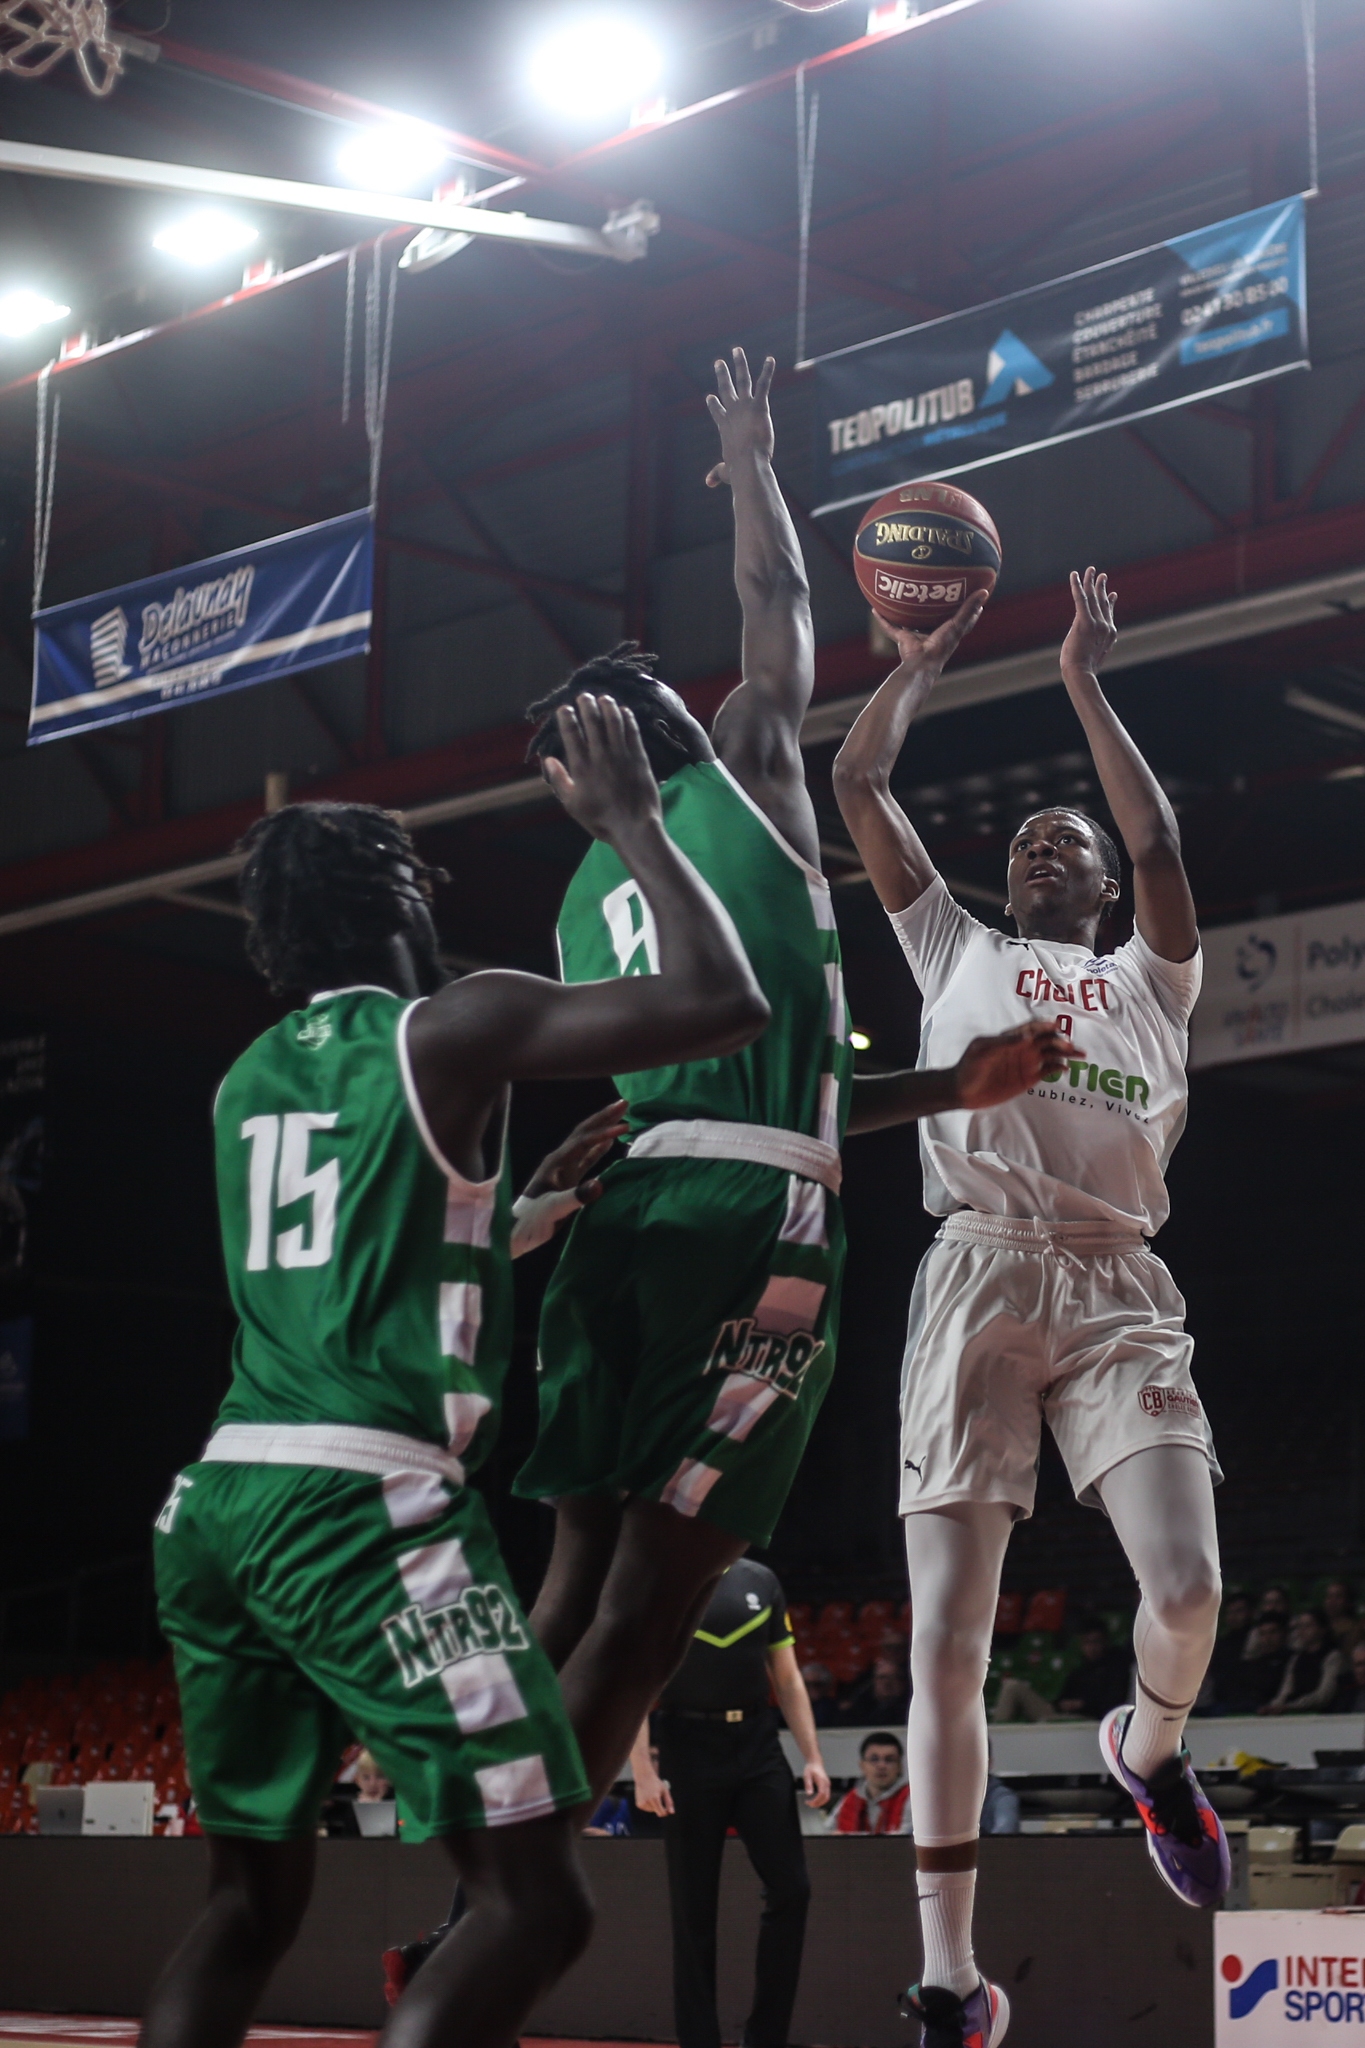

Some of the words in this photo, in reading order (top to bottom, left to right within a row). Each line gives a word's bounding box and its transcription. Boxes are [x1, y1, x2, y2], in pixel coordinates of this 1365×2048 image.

[828, 377, 975, 455] TEOPOLITUB
[875, 522, 975, 555] SPALDING
[878, 575, 963, 603] Betclic
[1027, 1086, 1094, 1109] eublez,
[241, 1112, 340, 1271] 15
[1142, 1391, 1163, 1410] CB
